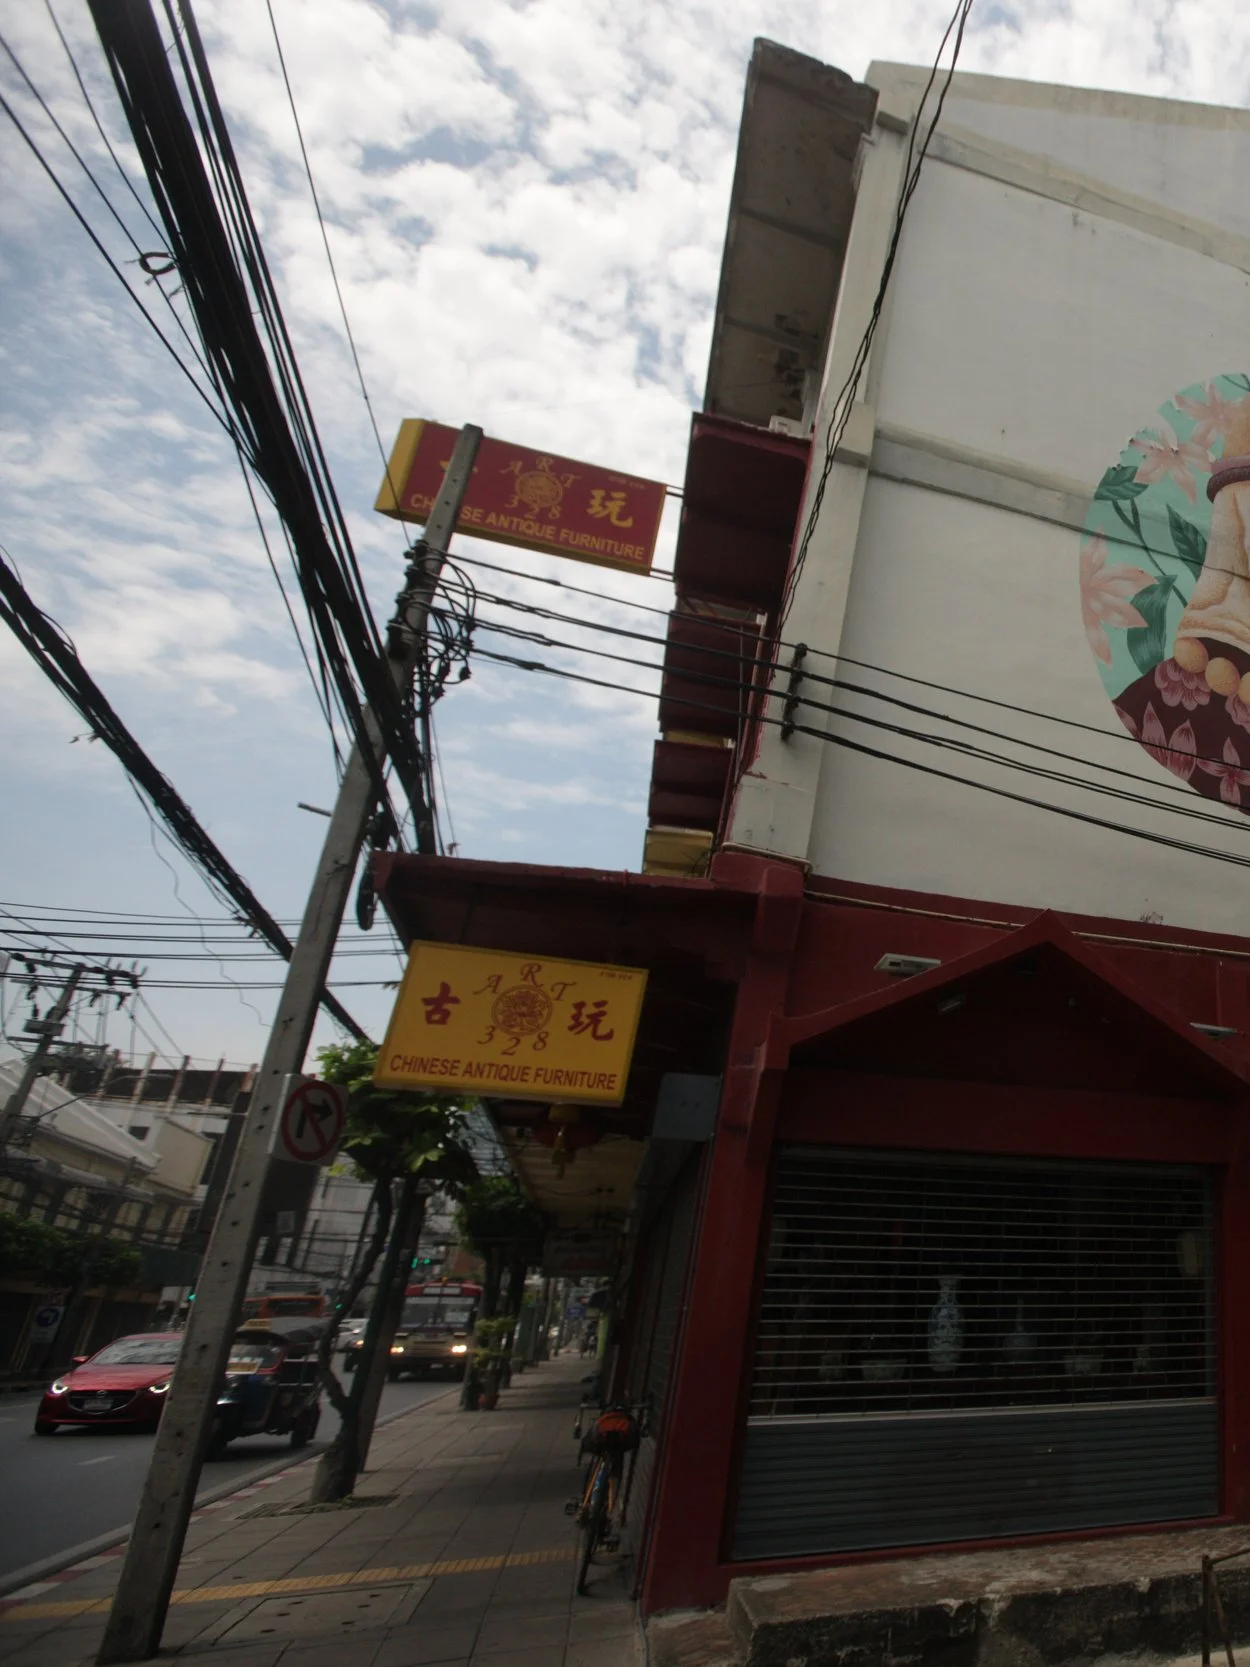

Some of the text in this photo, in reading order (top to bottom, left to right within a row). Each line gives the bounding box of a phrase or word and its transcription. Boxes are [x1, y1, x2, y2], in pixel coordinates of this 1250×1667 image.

[410, 493, 645, 560] CHSE ANTIQUE FURNITURE
[390, 1054, 618, 1091] CHINESE ANTIQUE FURNITURE
